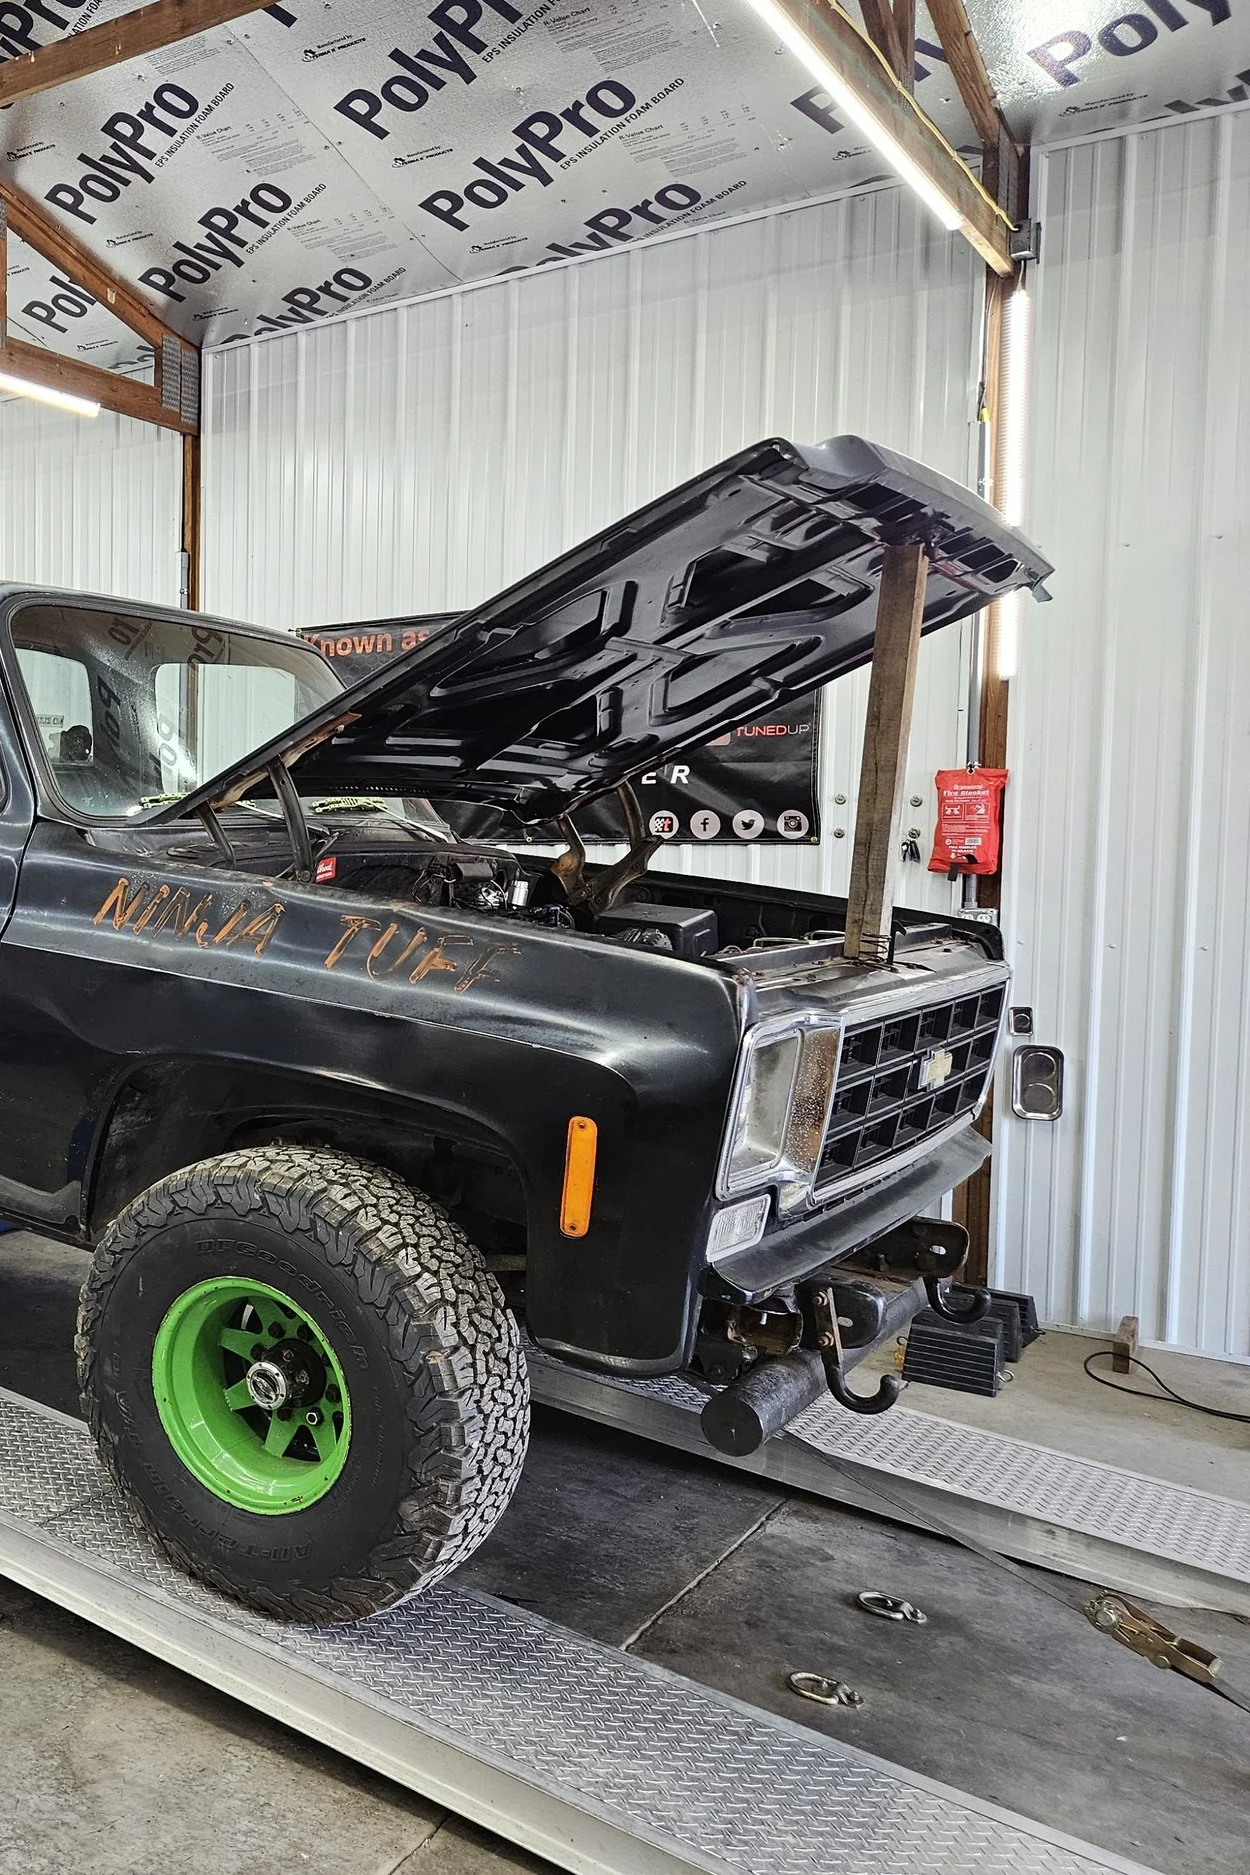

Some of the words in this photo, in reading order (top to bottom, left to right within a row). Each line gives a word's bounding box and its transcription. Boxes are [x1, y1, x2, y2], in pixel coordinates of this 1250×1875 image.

[333, 0, 524, 140] PolyP
[481, 47, 501, 64] EPS
[497, 3, 551, 49] INSULATION
[44, 82, 199, 225] PolyPro
[154, 154, 169, 168] EPS
[165, 122, 199, 158] INSULATION
[195, 104, 215, 126] FOAM
[211, 82, 235, 107] BOARD
[418, 80, 636, 232] PolyPro
[559, 154, 578, 171] EPS
[575, 121, 627, 160] INSULATION
[624, 103, 653, 125] FOAM
[650, 77, 685, 106] BOARD
[138, 182, 292, 303] PolyPro
[245, 243, 260, 255] EPS
[256, 215, 291, 246] INSULATION
[287, 202, 304, 219] FOAM
[302, 183, 327, 205] BOARD
[690, 196, 716, 215] FOAM
[716, 180, 747, 200] BOARD
[383, 267, 406, 283] BOARD
[736, 723, 810, 737] TUNEDUP
[93, 877, 287, 958] NINJA
[324, 914, 523, 994] TUFF
